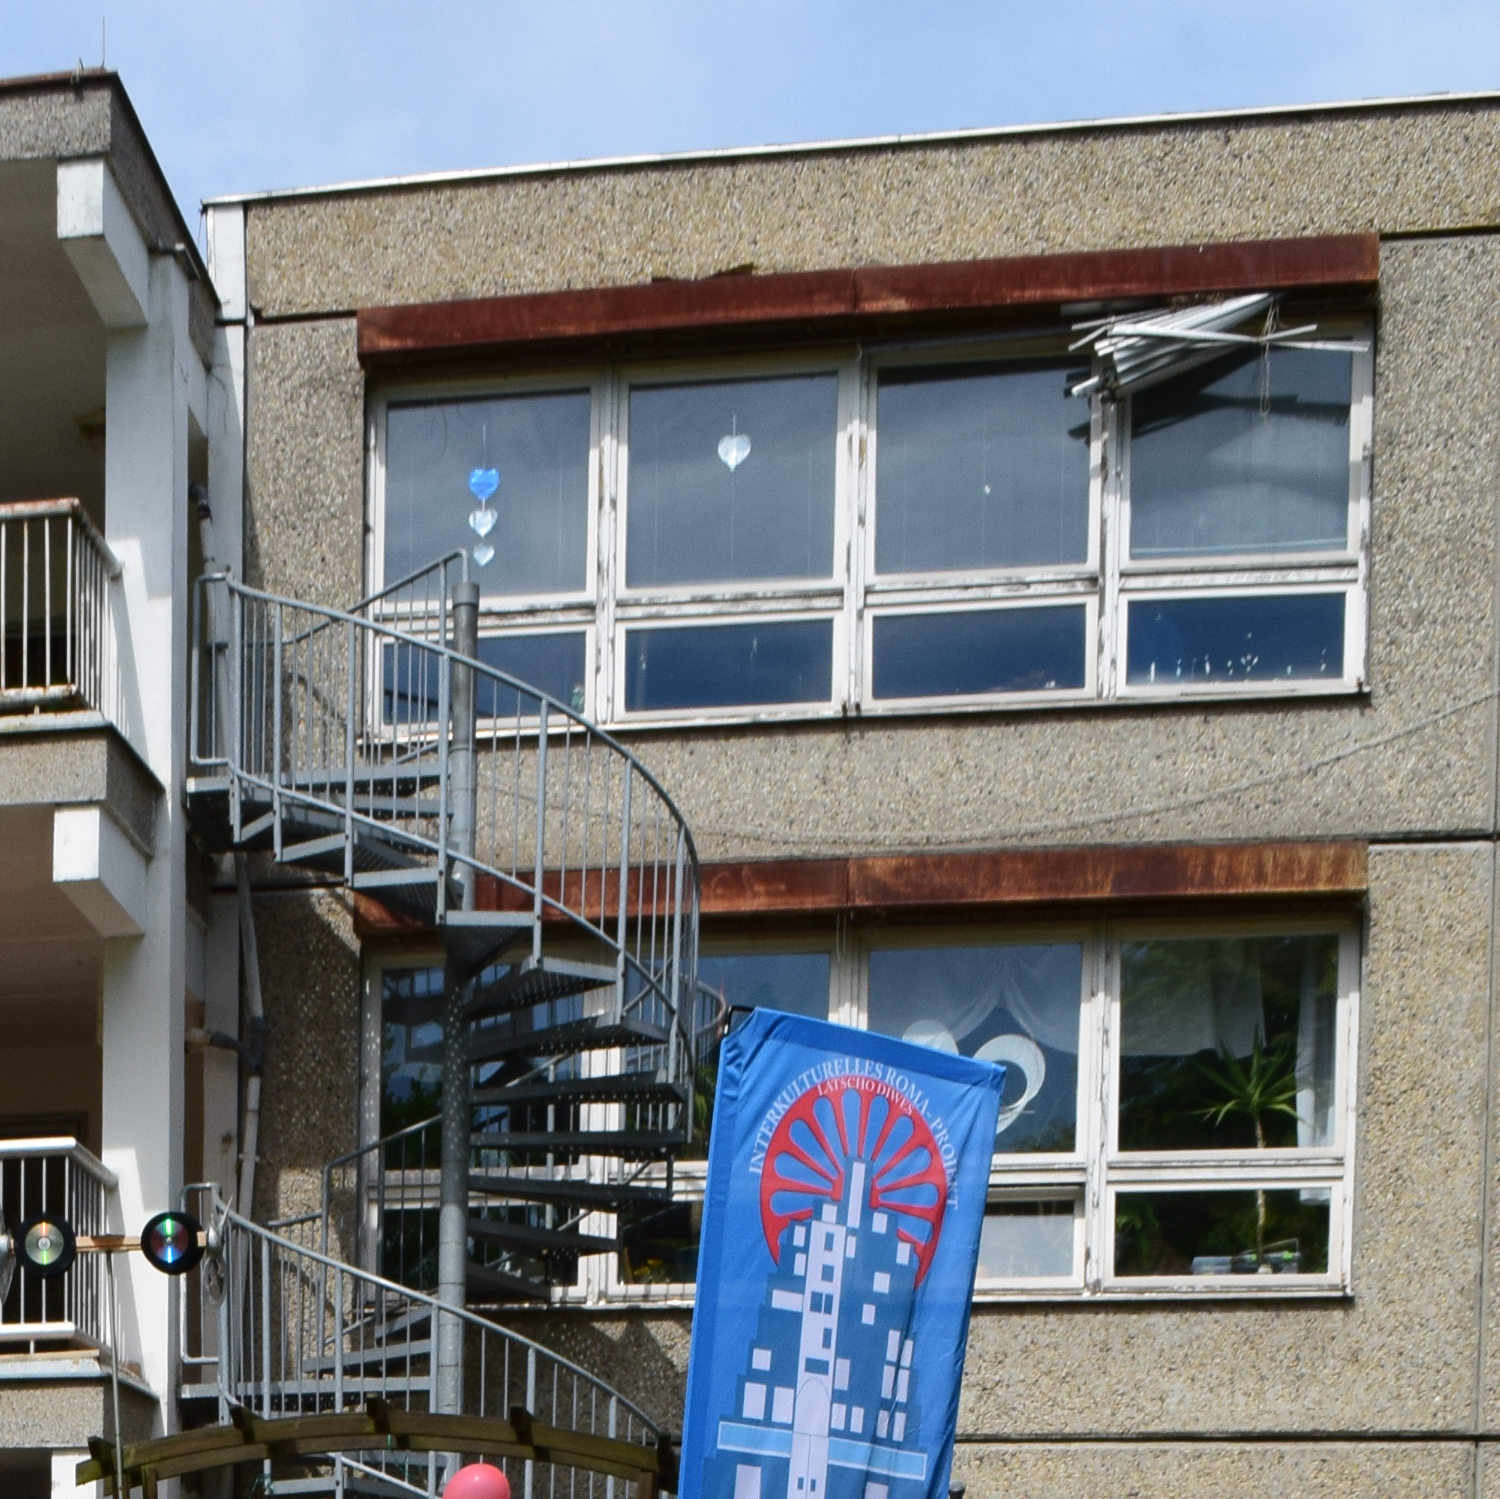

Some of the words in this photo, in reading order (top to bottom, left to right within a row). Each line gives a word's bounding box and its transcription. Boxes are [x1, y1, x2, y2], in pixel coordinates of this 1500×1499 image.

[749, 1057, 883, 1174] INTERKULTURELLES
[817, 1077, 875, 1097] LATSCHO
[876, 1082, 914, 1116] DIWES
